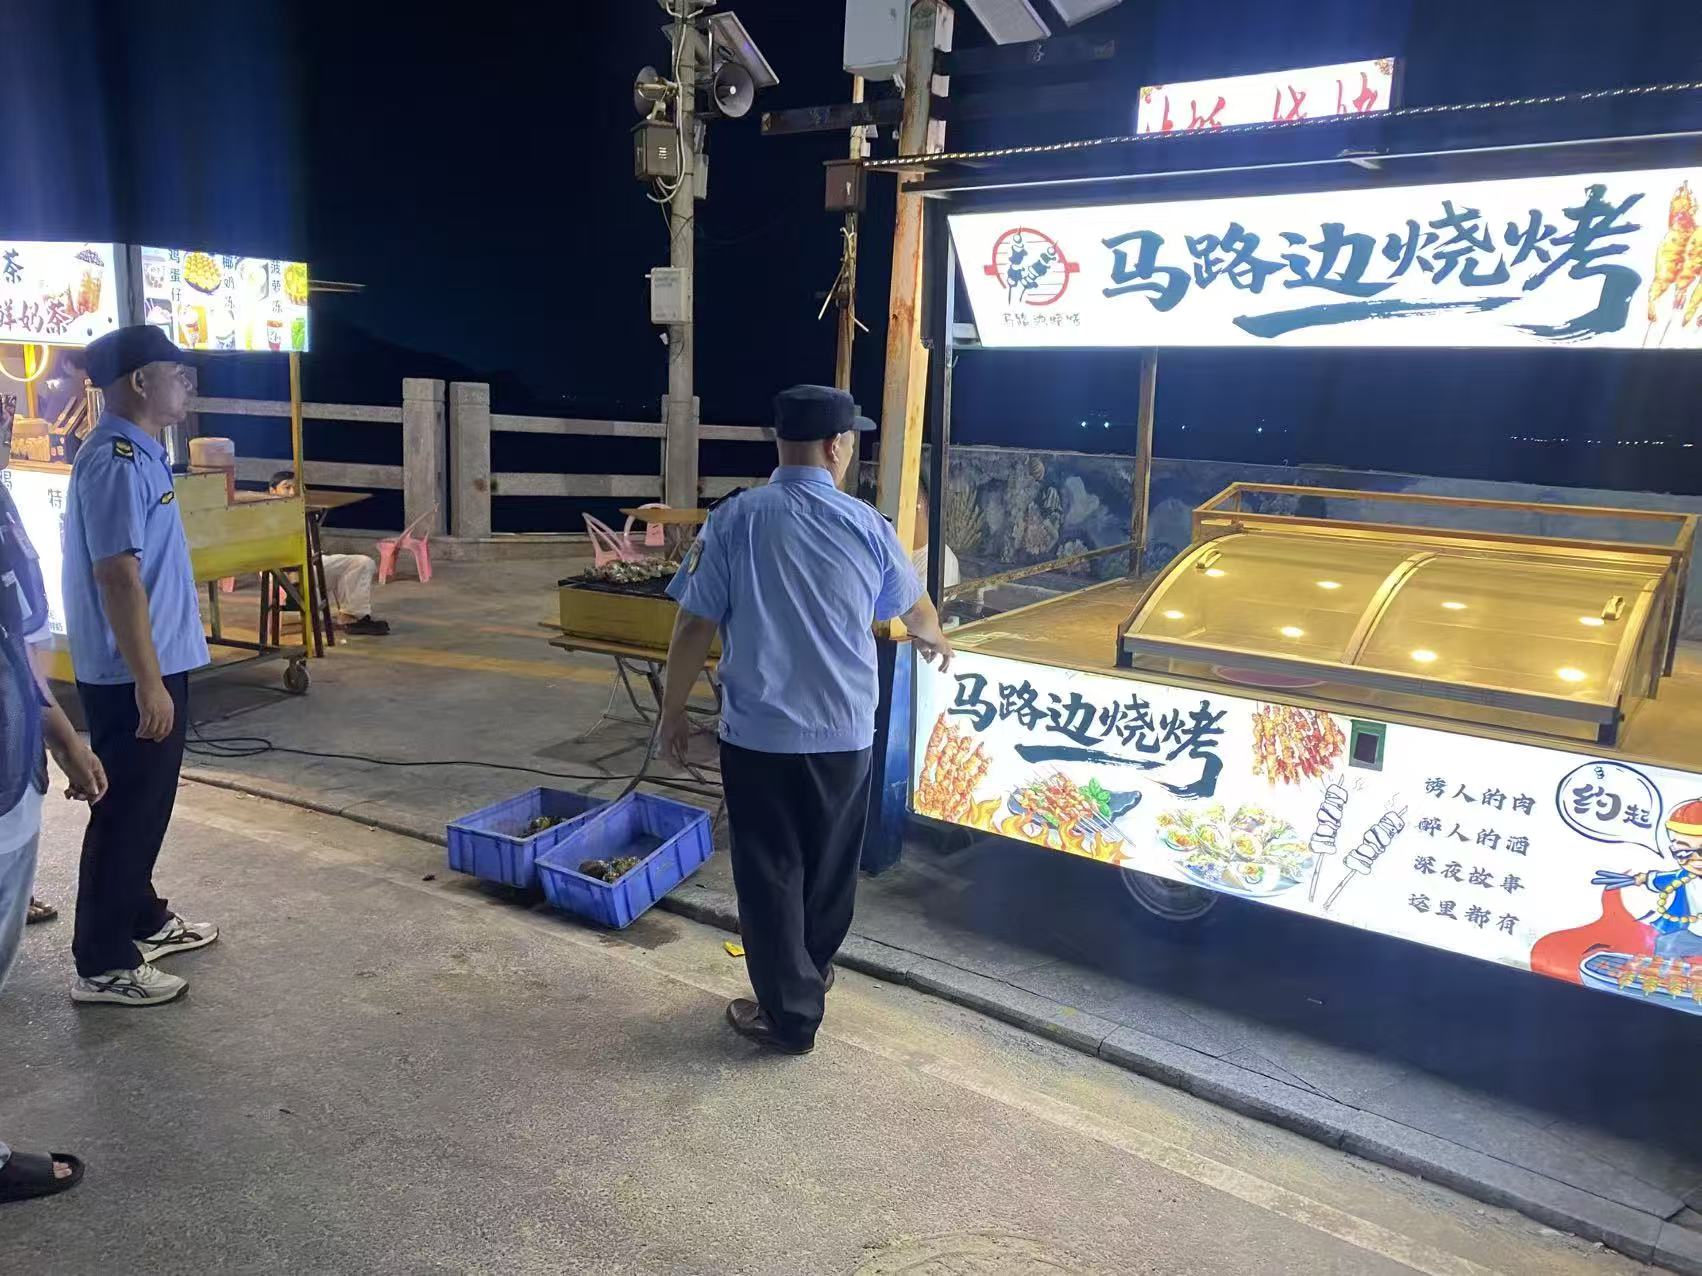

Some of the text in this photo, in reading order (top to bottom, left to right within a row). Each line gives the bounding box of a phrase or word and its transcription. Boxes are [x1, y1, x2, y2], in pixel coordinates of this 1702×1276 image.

[3, 248, 24, 284] 茶
[1102, 184, 1645, 342] 马路边烧烤
[948, 673, 1227, 800] 马路边烧烤
[1425, 777, 1536, 816] 诱人的肉
[1572, 784, 1652, 829] 约起
[1418, 817, 1531, 856] 醉人的酒
[1413, 855, 1525, 894] 深夜故事
[1408, 893, 1520, 935] 这里都有
